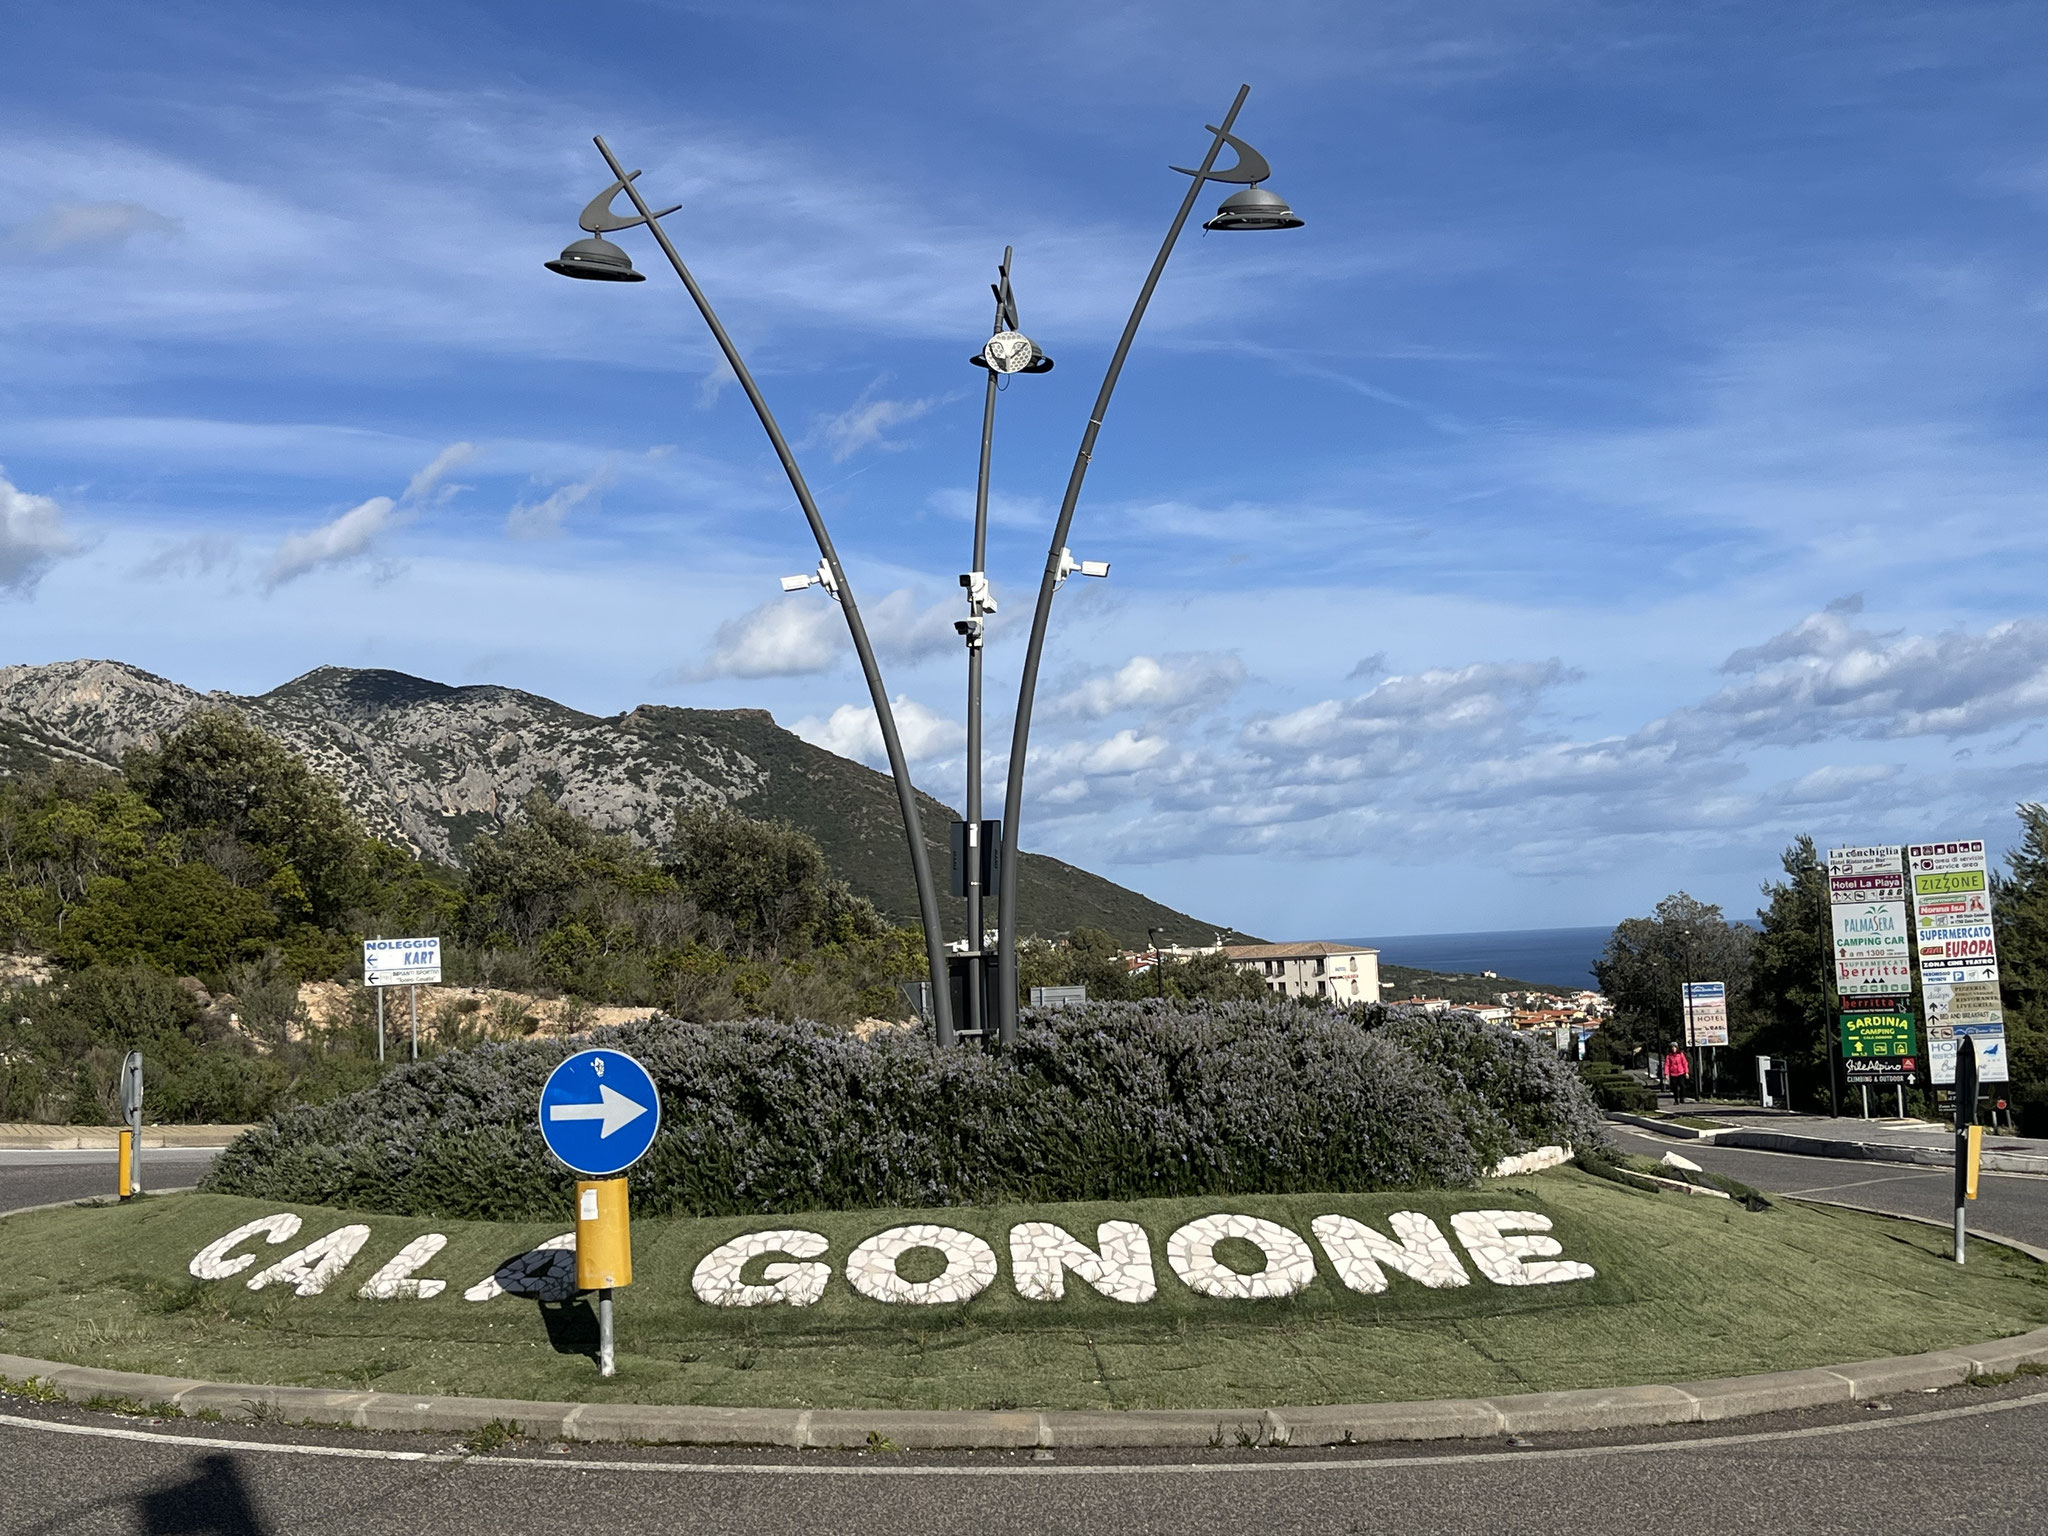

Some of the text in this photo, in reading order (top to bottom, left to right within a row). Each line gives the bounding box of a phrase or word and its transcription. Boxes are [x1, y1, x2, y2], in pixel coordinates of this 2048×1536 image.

[1832, 879, 1900, 889] Hotel La Playa
[1921, 873, 1979, 892] ZIZZONE
[1921, 906, 1949, 914] Nonna
[1844, 916, 1894, 932] PALMASERA
[1837, 936, 1904, 946] CAMPING CAR
[1920, 926, 1991, 941] SUPERMERCATO
[366, 940, 437, 950] NOLEGGIO
[1946, 940, 1994, 957] EUROPA
[404, 951, 434, 965] KART
[1839, 962, 1908, 977] berritta
[1842, 996, 1894, 1009] berritta
[1846, 1016, 1908, 1031] SARDINIA
[189, 1210, 1596, 1306] CALA GONONE
